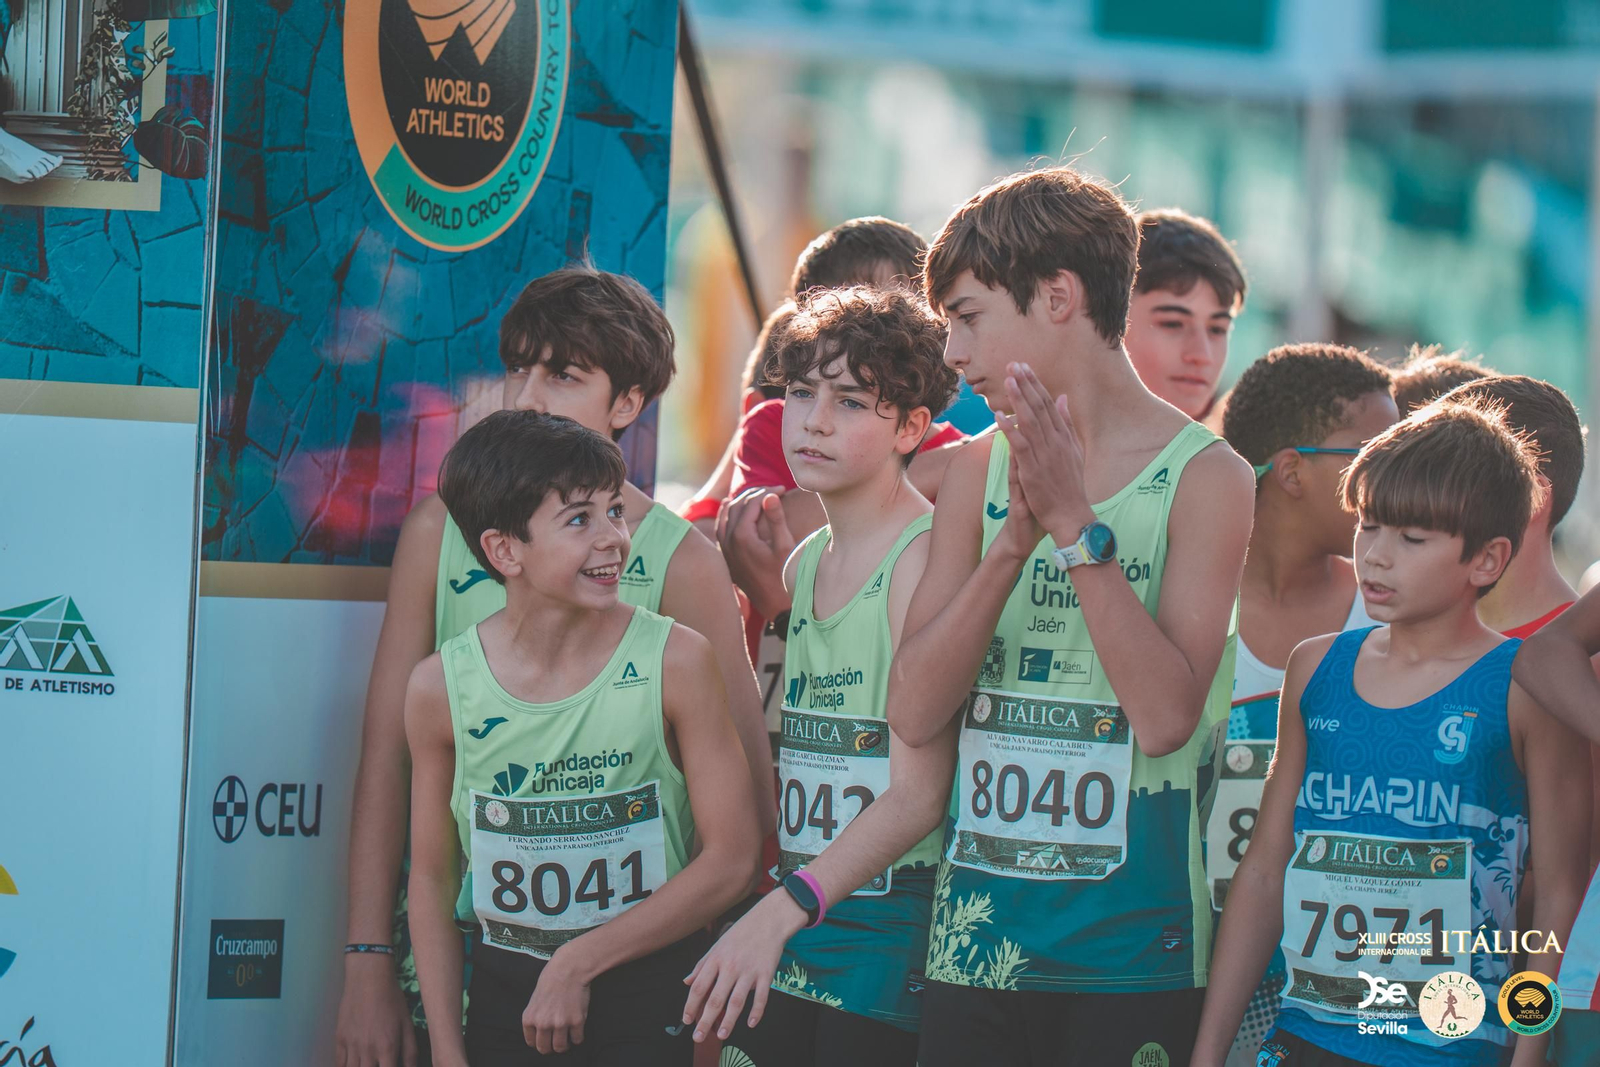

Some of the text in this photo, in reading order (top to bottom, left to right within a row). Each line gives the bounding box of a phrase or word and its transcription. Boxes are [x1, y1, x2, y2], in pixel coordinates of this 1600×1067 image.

[425, 77, 491, 107] WORLD
[406, 108, 504, 142] ATHLETICS
[405, 184, 463, 230] WORLD
[467, 172, 520, 228] CROSS
[518, 44, 559, 176] COUNTRY
[1027, 615, 1066, 634] Jaén
[5, 677, 115, 696] DE ATLETISMO
[809, 667, 863, 688] Fundación
[809, 690, 844, 711] Unicaja
[1443, 703, 1480, 713] CHAPIN
[998, 700, 1080, 728] ITÁLICA
[1308, 715, 1340, 732] vive
[784, 715, 842, 742] ITÁLICA
[986, 734, 1093, 750] ALVARO NAVARRO CALABRUS
[1026, 746, 1052, 754] PARAISO
[1054, 749, 1086, 757] INTERIOR
[533, 749, 633, 778] Fundación
[796, 752, 817, 761] GARCIA
[822, 764, 849, 772] INTERIOR
[532, 772, 605, 794] Unicaja
[971, 759, 1115, 830] 8040
[1305, 771, 1460, 824] CHAPIN
[255, 783, 323, 836] CEU
[522, 803, 615, 826] ITÁLICA
[508, 827, 630, 844] FERNANDO SERRANO SANCHEZ
[593, 836, 624, 847] INTERIOR
[1332, 840, 1416, 866] ITÁLICA
[491, 850, 652, 916] 8041
[1324, 874, 1353, 883] MIGUEL
[1300, 900, 1455, 966] 7971
[216, 934, 278, 959] Cruzcampo
